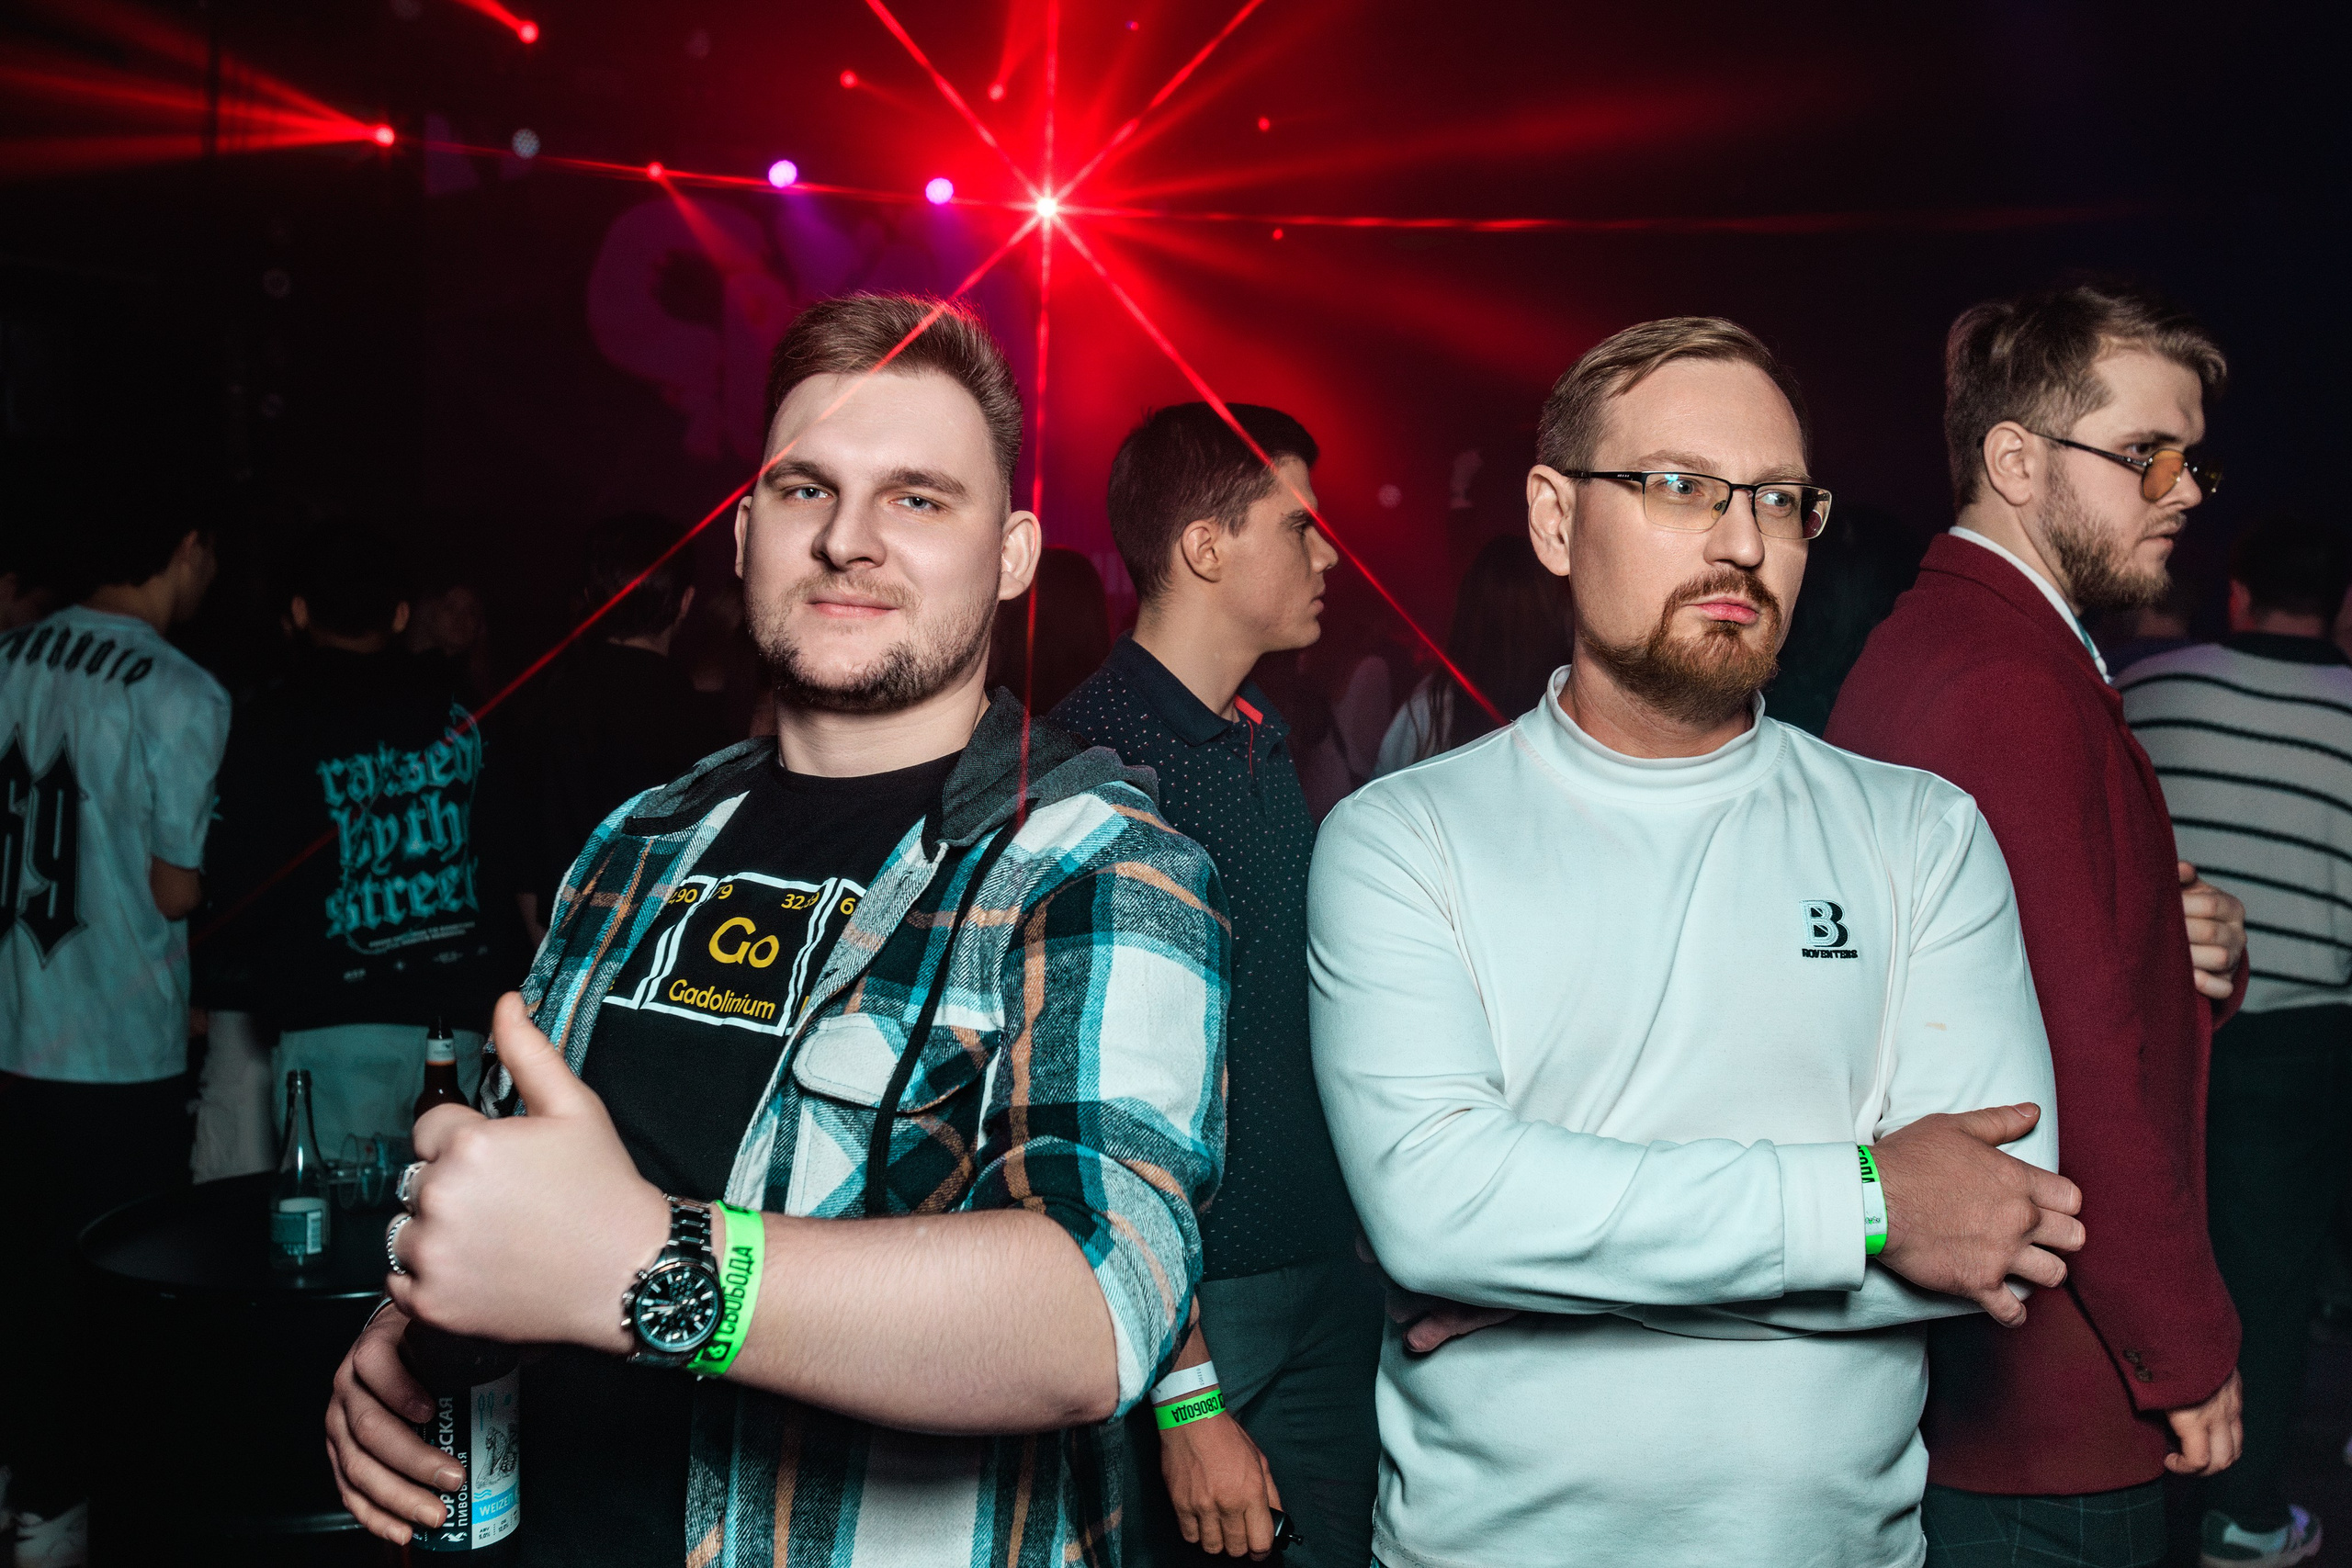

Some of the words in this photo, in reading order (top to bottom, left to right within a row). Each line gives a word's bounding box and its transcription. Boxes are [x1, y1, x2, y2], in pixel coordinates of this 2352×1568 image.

[708, 916, 780, 968] Go
[668, 978, 776, 1020] Gadolinium
[1171, 1396, 1219, 1423] СВОБОДА
[438, 1396, 455, 1528] ГОРВСКАЯ
